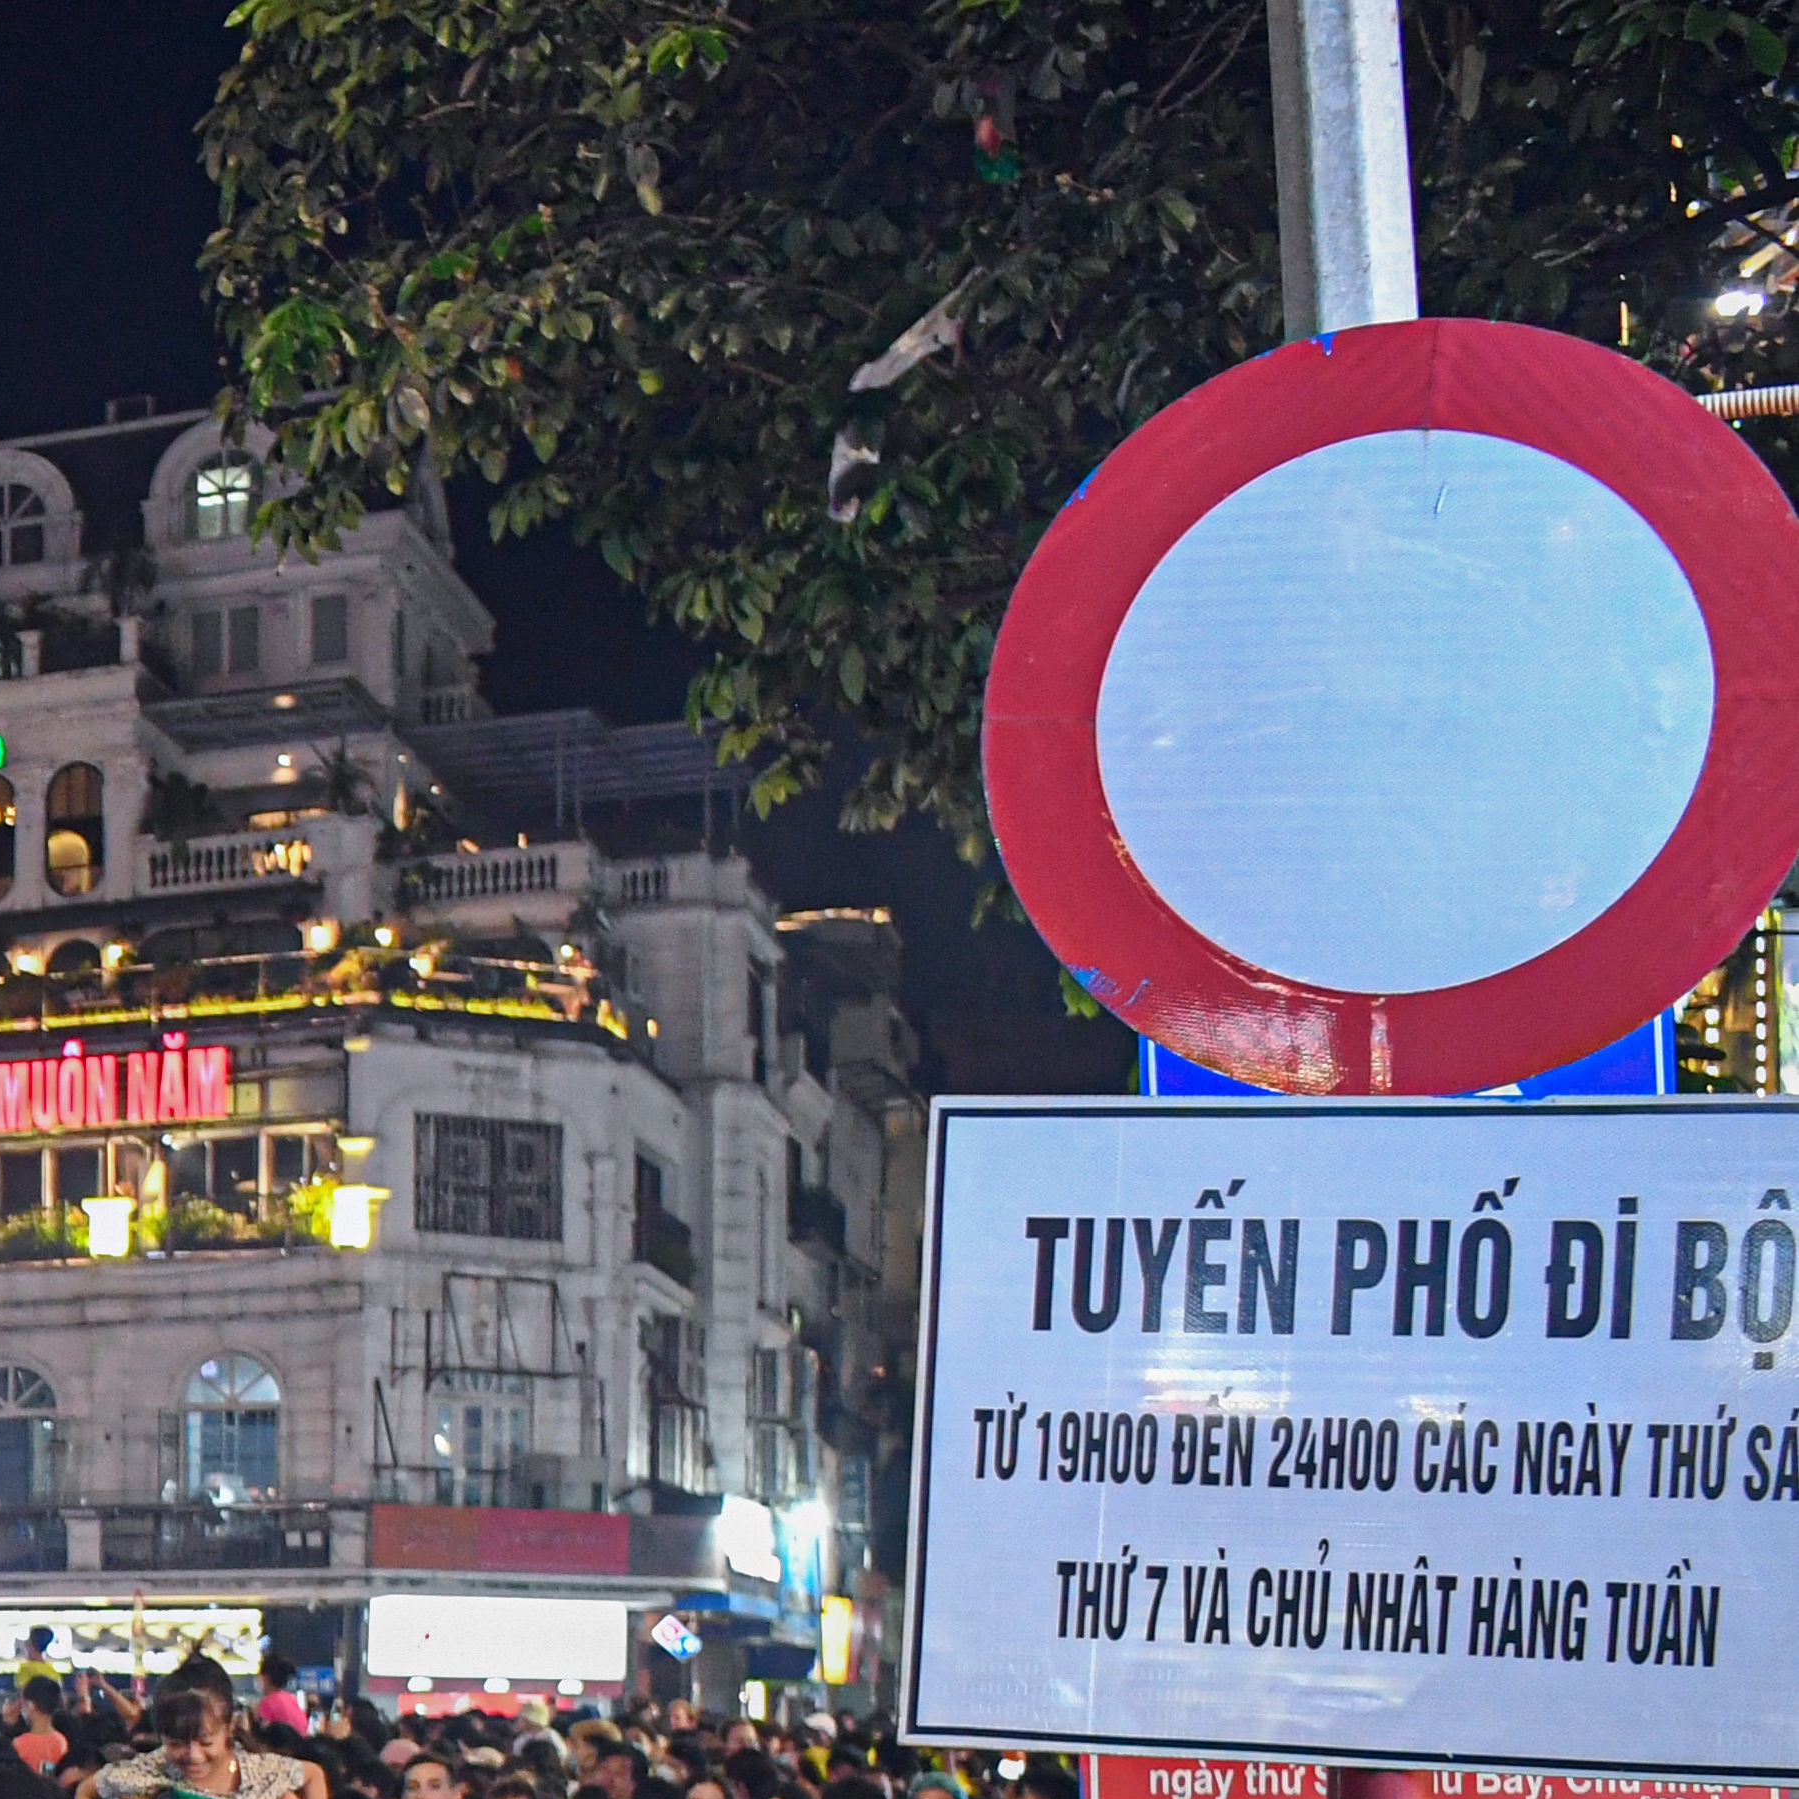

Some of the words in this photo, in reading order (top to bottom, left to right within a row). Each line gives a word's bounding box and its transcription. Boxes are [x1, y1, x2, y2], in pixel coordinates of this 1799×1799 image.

[126, 1031, 230, 1124] NĂM
[1024, 1178, 1301, 1336] TUYẾN
[1331, 1176, 1521, 1339] PHỐ
[1670, 1187, 1796, 1371] BỘ
[973, 1391, 1029, 1481] TỪ
[1036, 1407, 1160, 1486] 19H00
[1170, 1386, 1257, 1488] ĐẾN
[1267, 1416, 1400, 1493] 24H00
[1413, 1402, 1499, 1495] CÁC
[1513, 1402, 1633, 1499] NGÀY
[1647, 1403, 1738, 1501] THỨ
[1742, 1408, 1799, 1503] SÁ
[1056, 1543, 1139, 1641] THỨ
[1145, 1565, 1169, 1643] 7
[1181, 1546, 1232, 1647] VÀ
[1245, 1537, 1333, 1650] CHỦ
[1605, 1557, 1721, 1668] TUẦN
[1244, 1760, 1306, 1796] thứ
